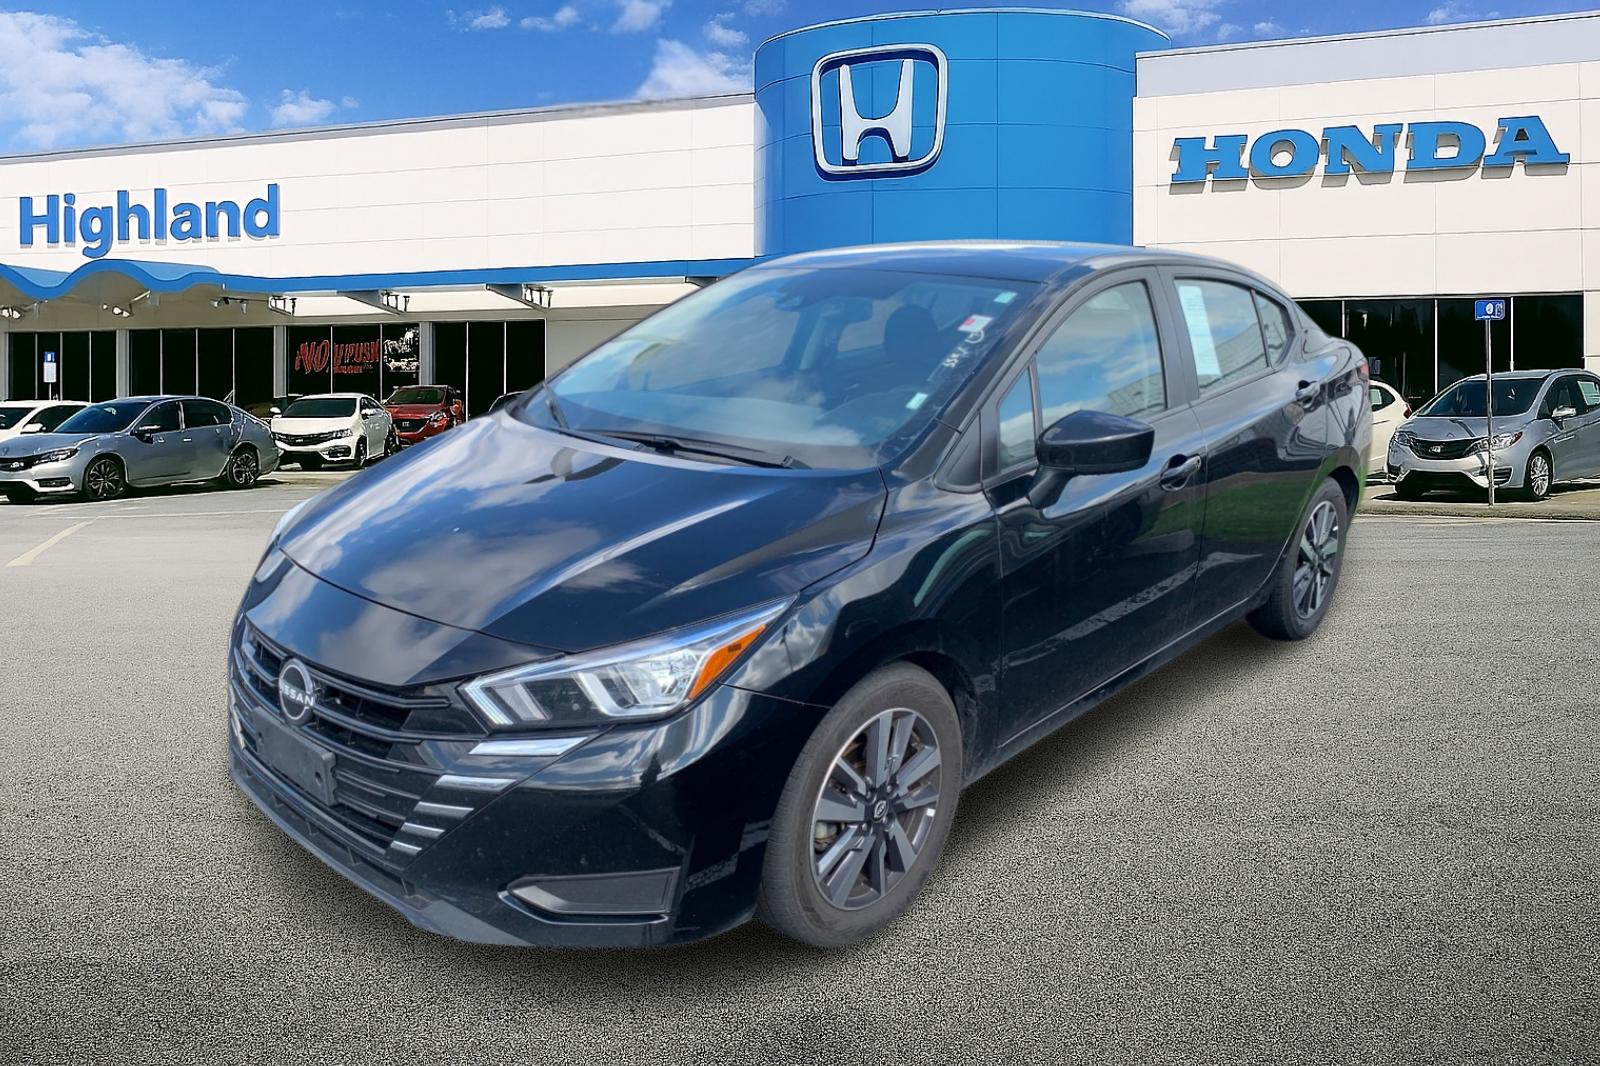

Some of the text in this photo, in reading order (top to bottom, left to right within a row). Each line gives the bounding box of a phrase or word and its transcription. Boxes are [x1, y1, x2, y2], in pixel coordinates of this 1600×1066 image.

[1171, 115, 1571, 183] HONDA
[19, 183, 281, 259] Highland
[279, 679, 315, 706] SSAN
